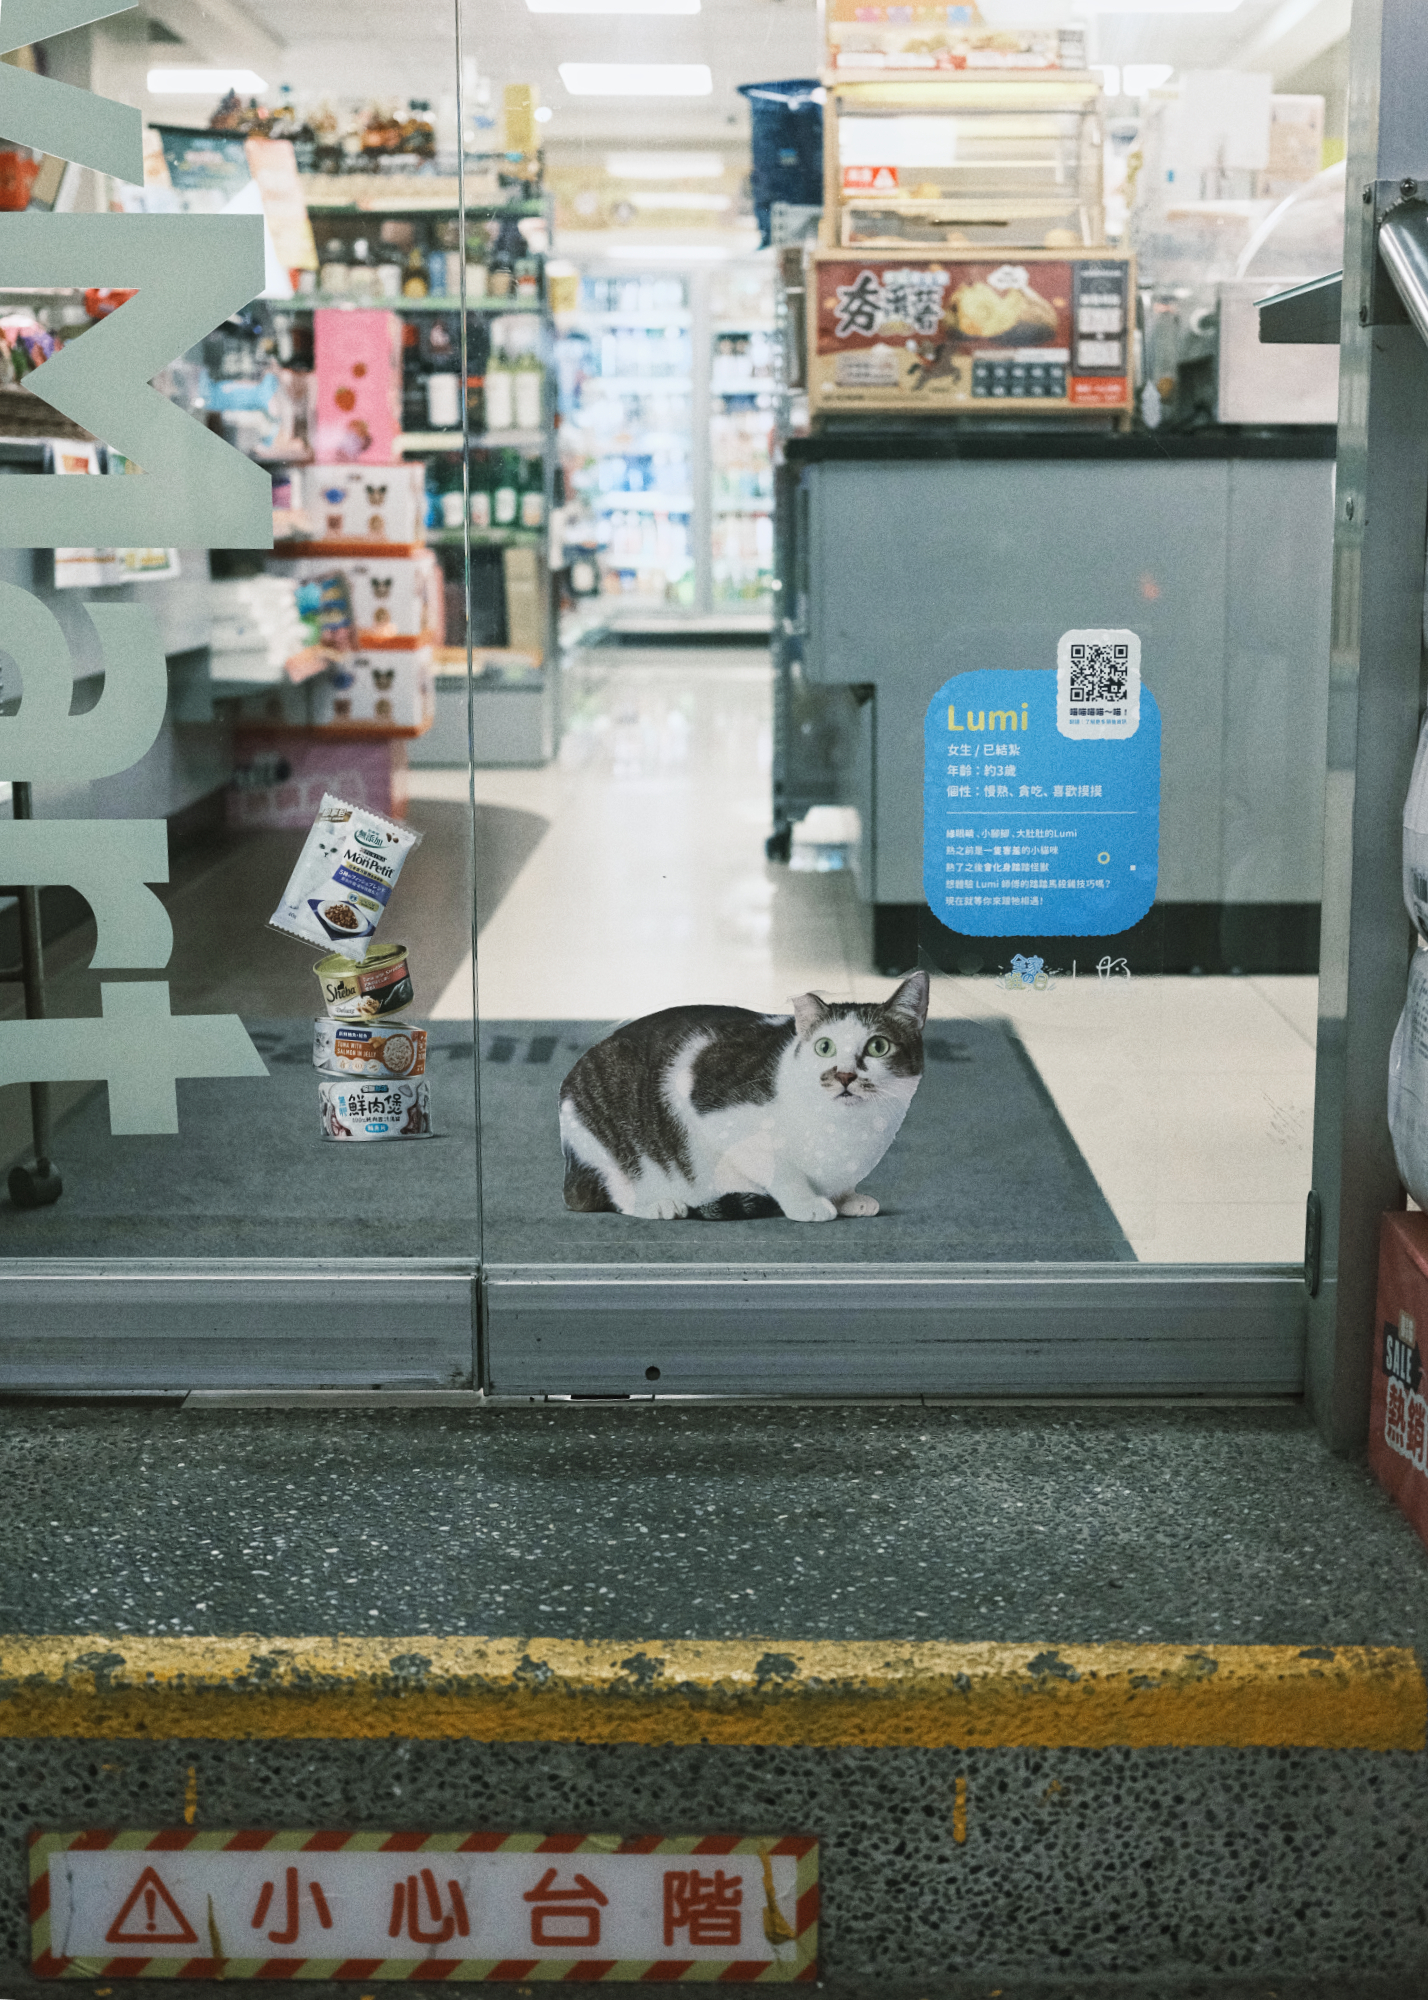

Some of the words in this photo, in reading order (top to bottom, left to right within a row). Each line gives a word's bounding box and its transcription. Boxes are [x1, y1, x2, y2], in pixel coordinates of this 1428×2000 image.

[947, 702, 1029, 731] Lumi
[947, 744, 972, 757] 女生
[983, 744, 1021, 757] 已結紮
[976, 880, 999, 888] Lumi
[326, 983, 357, 1002] Sheba
[1386, 1334, 1413, 1384] SALE
[251, 1866, 744, 1946] 小心台階
